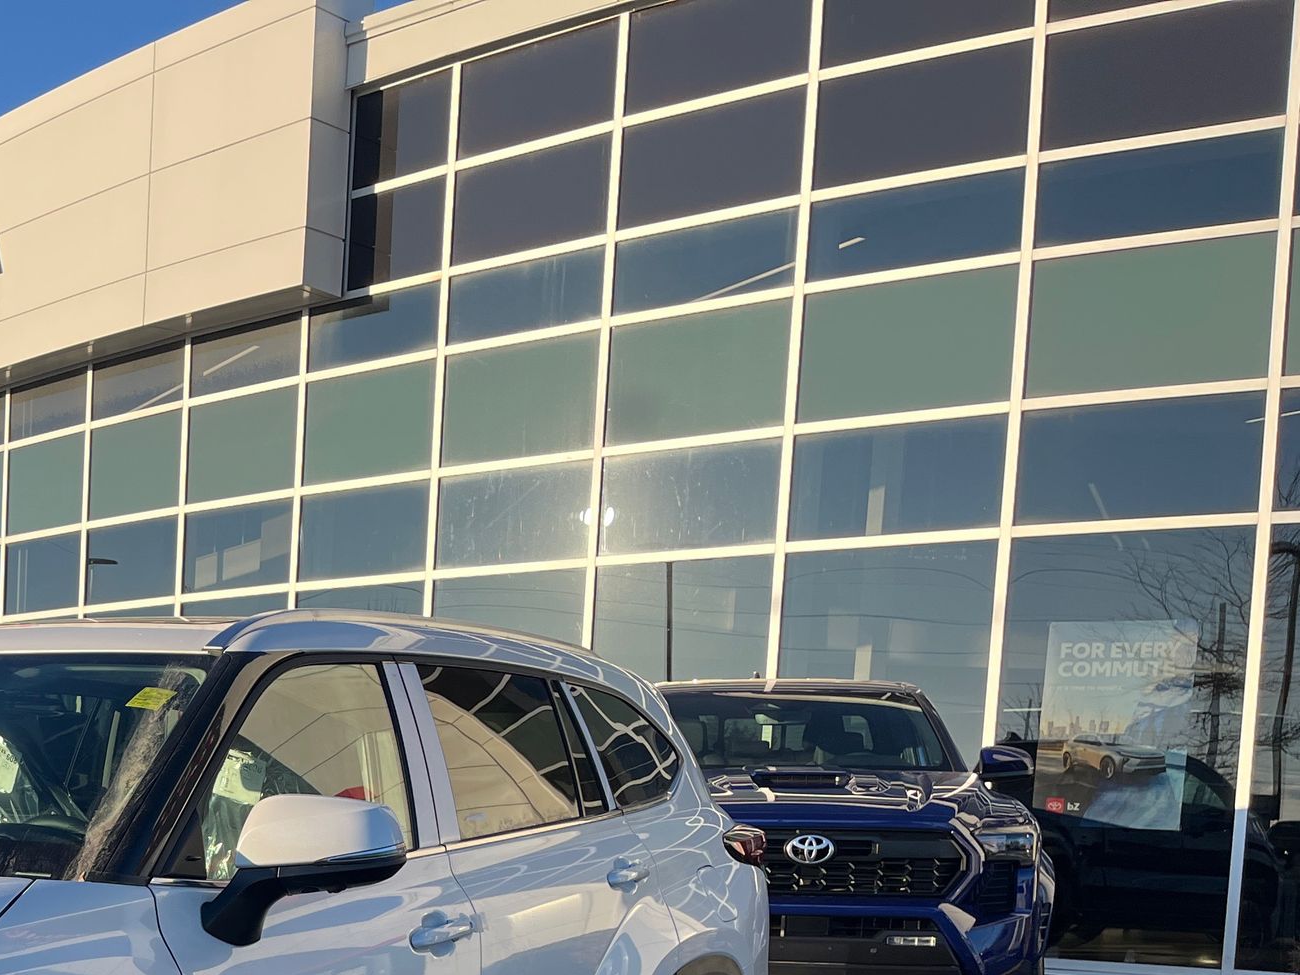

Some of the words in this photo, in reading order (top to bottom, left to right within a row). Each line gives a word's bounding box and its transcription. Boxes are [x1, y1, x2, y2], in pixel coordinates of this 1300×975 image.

[1060, 642, 1105, 659] FOR
[1110, 641, 1181, 659] EVERY
[1058, 661, 1177, 678] COMMUTE
[1066, 802, 1081, 811] bZ
